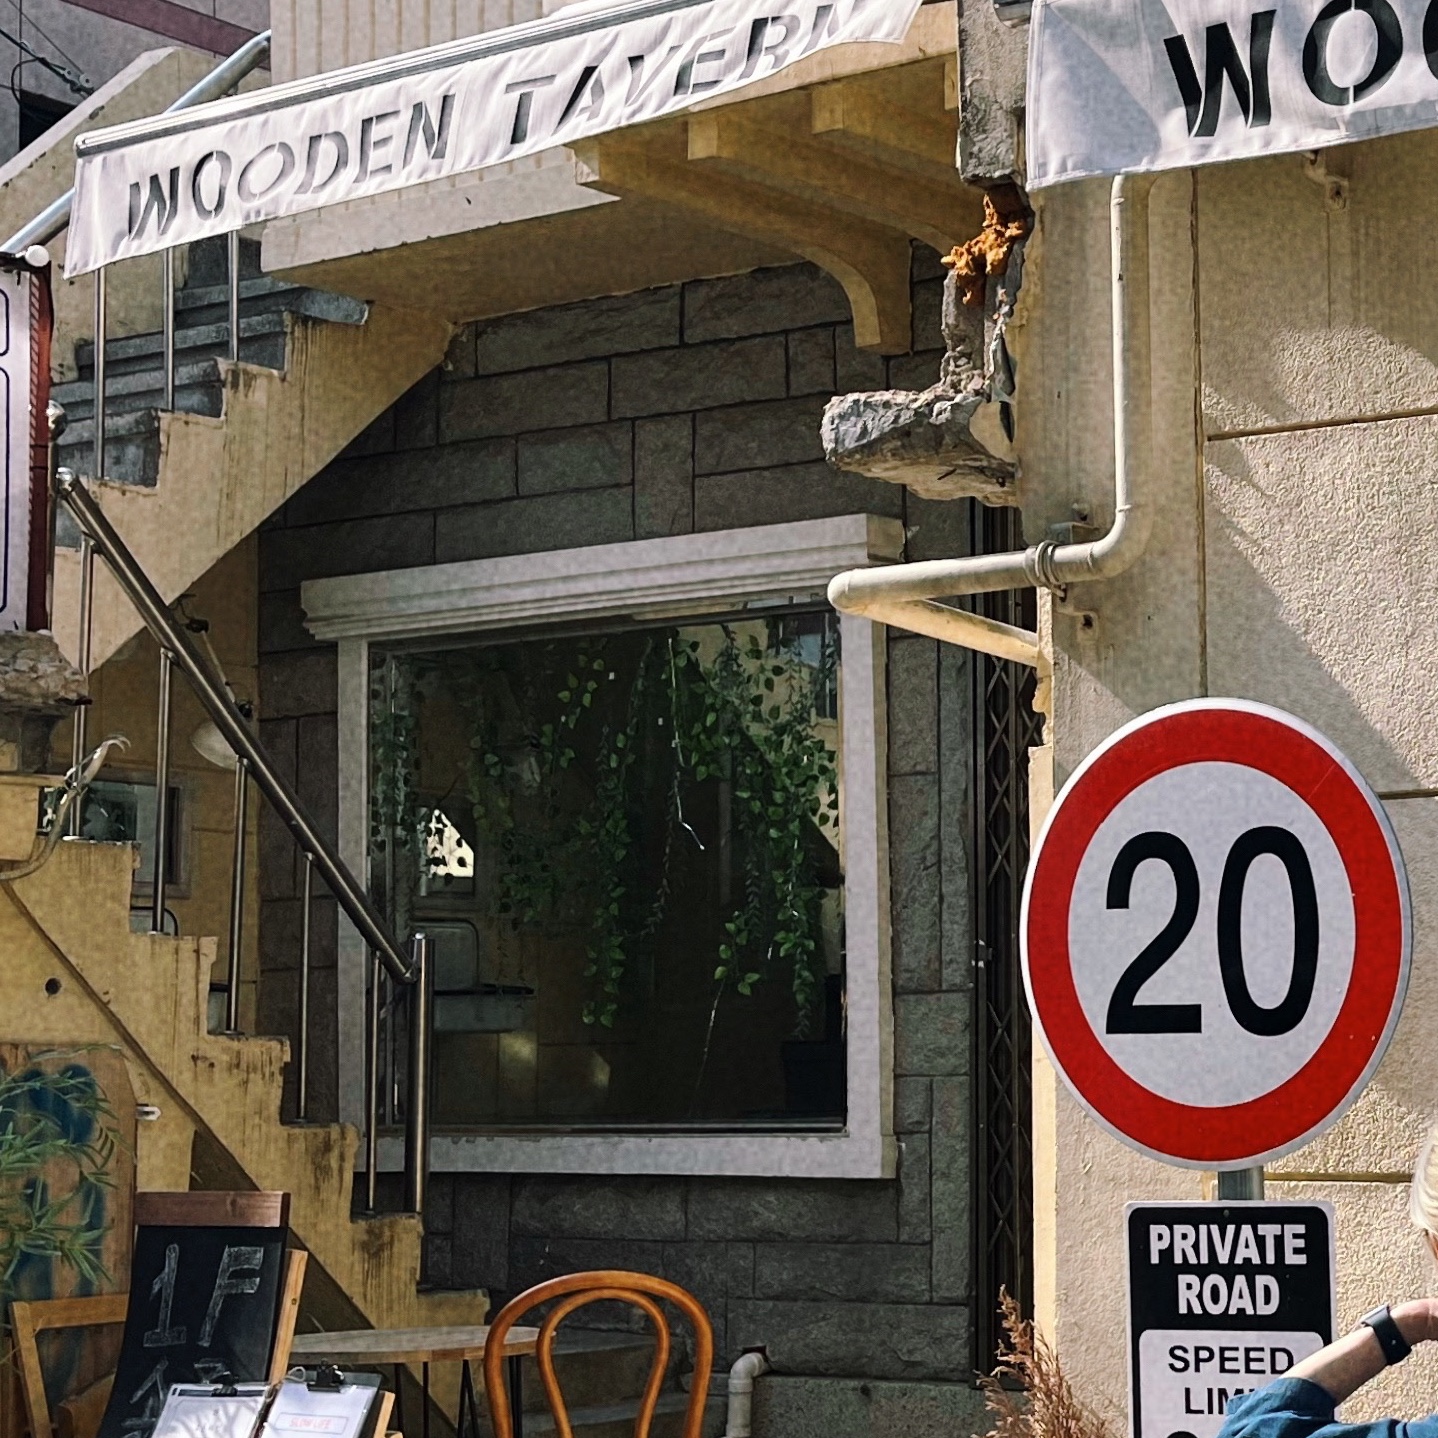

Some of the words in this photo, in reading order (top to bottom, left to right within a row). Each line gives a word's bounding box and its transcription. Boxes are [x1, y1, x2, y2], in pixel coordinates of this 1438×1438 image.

[127, 92, 456, 241] WOODEN
[1104, 825, 1321, 1037] 20
[1148, 1223, 1307, 1266] PRIVATE
[142, 1243, 264, 1348] 1F
[1177, 1273, 1280, 1316] ROAD
[1167, 1345, 1295, 1375] SPEED
